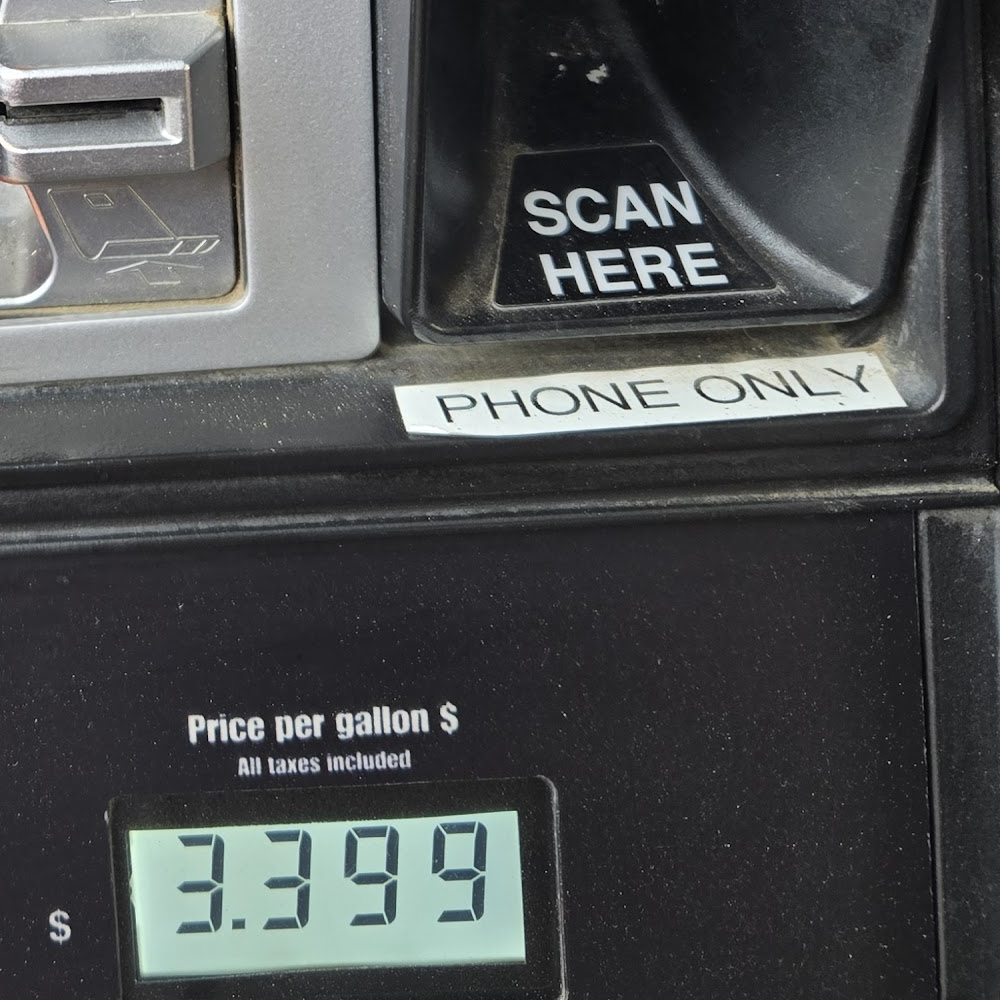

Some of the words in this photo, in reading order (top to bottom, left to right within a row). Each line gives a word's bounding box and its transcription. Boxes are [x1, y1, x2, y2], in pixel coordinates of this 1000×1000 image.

[523, 180, 704, 236] SCAN
[539, 241, 730, 297] HERE
[437, 380, 681, 424] PHONE
[692, 363, 875, 407] ONLY
[187, 712, 265, 745] Price
[275, 711, 325, 741] per
[335, 705, 430, 740] gallon
[439, 701, 460, 735] $
[237, 755, 262, 777] All
[268, 754, 321, 775] taxes
[327, 749, 412, 772] included
[176, 821, 487, 934] 3.399
[48, 908, 71, 944] $
